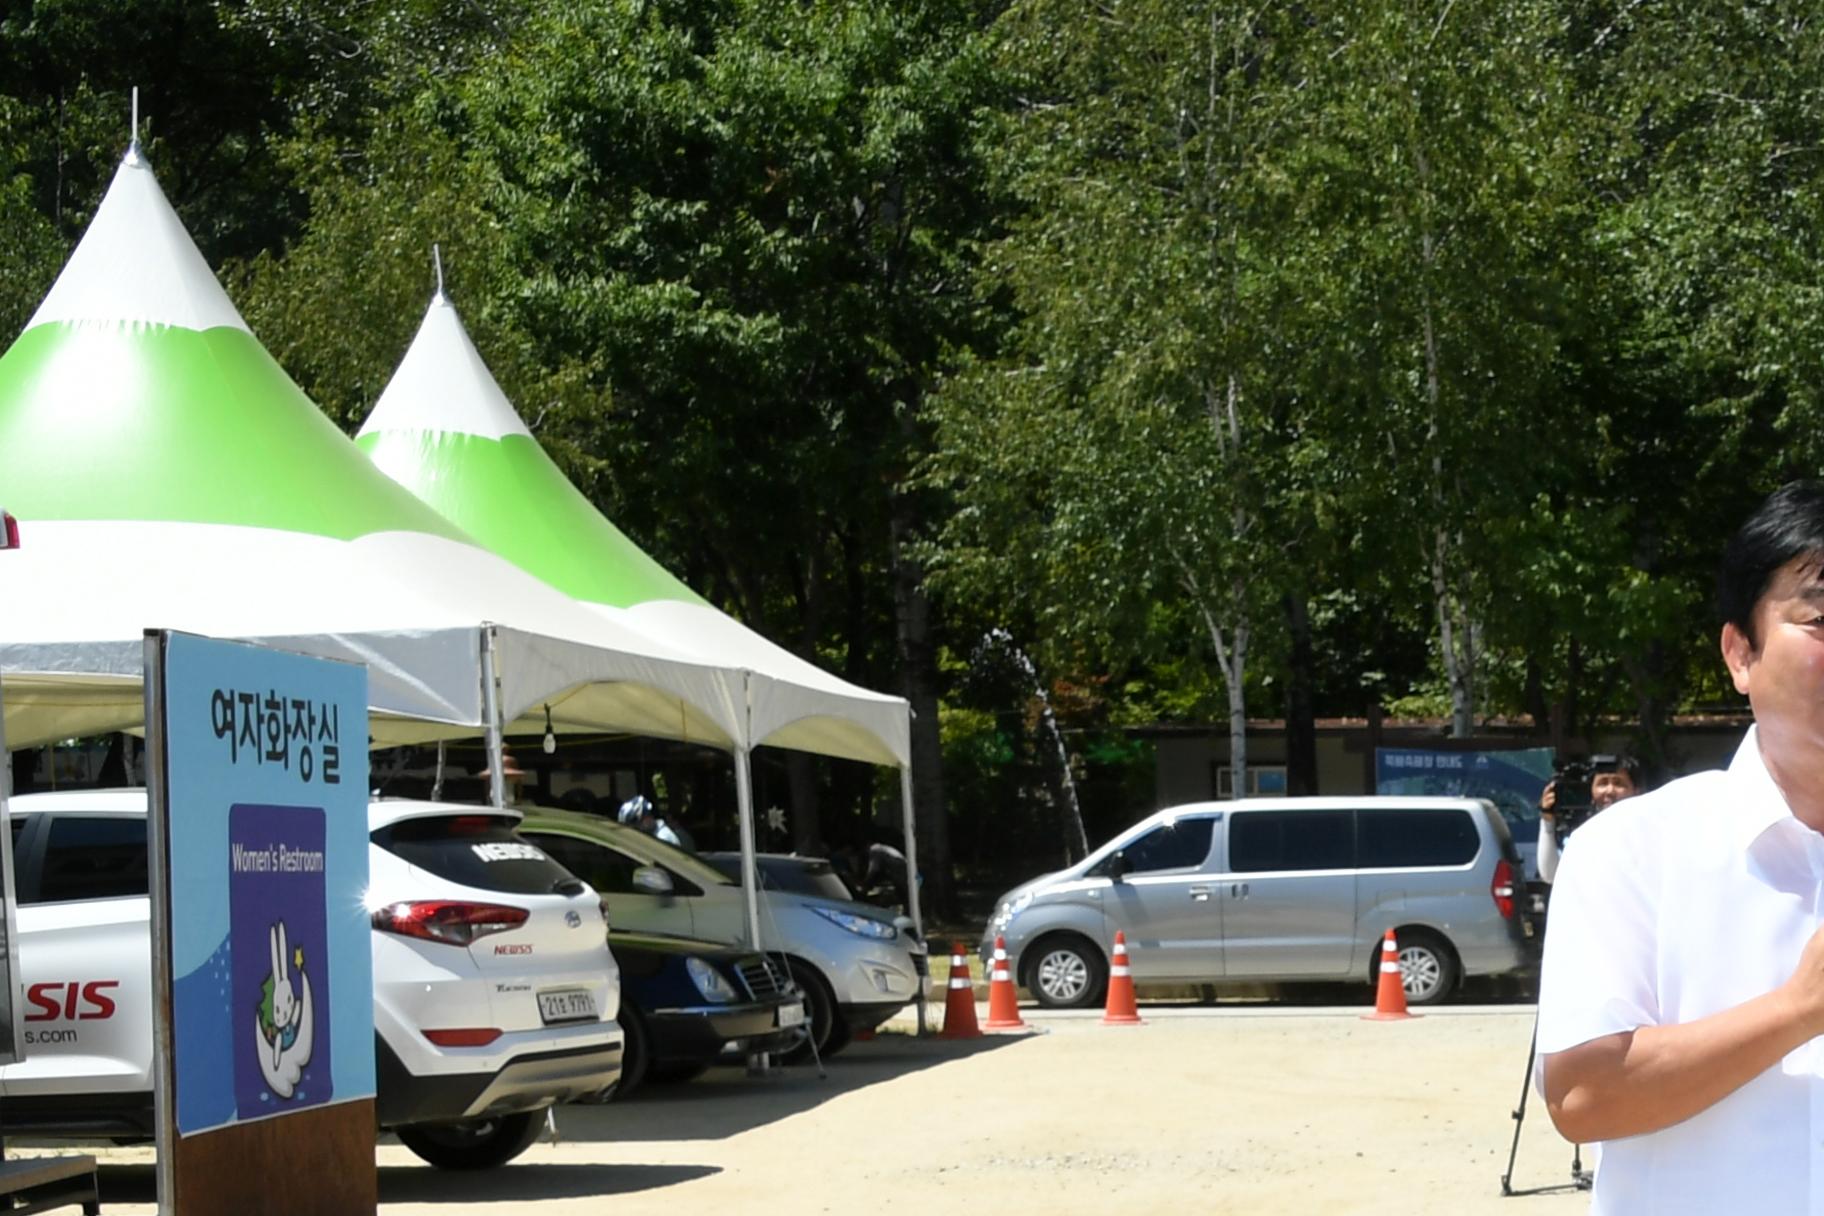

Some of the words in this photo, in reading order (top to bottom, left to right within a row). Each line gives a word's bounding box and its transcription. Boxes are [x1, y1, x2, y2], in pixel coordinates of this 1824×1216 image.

[211, 688, 340, 784] 여자화장실
[232, 843, 278, 872] Women's
[279, 843, 324, 872] Restroom
[21, 981, 119, 1022] SIS
